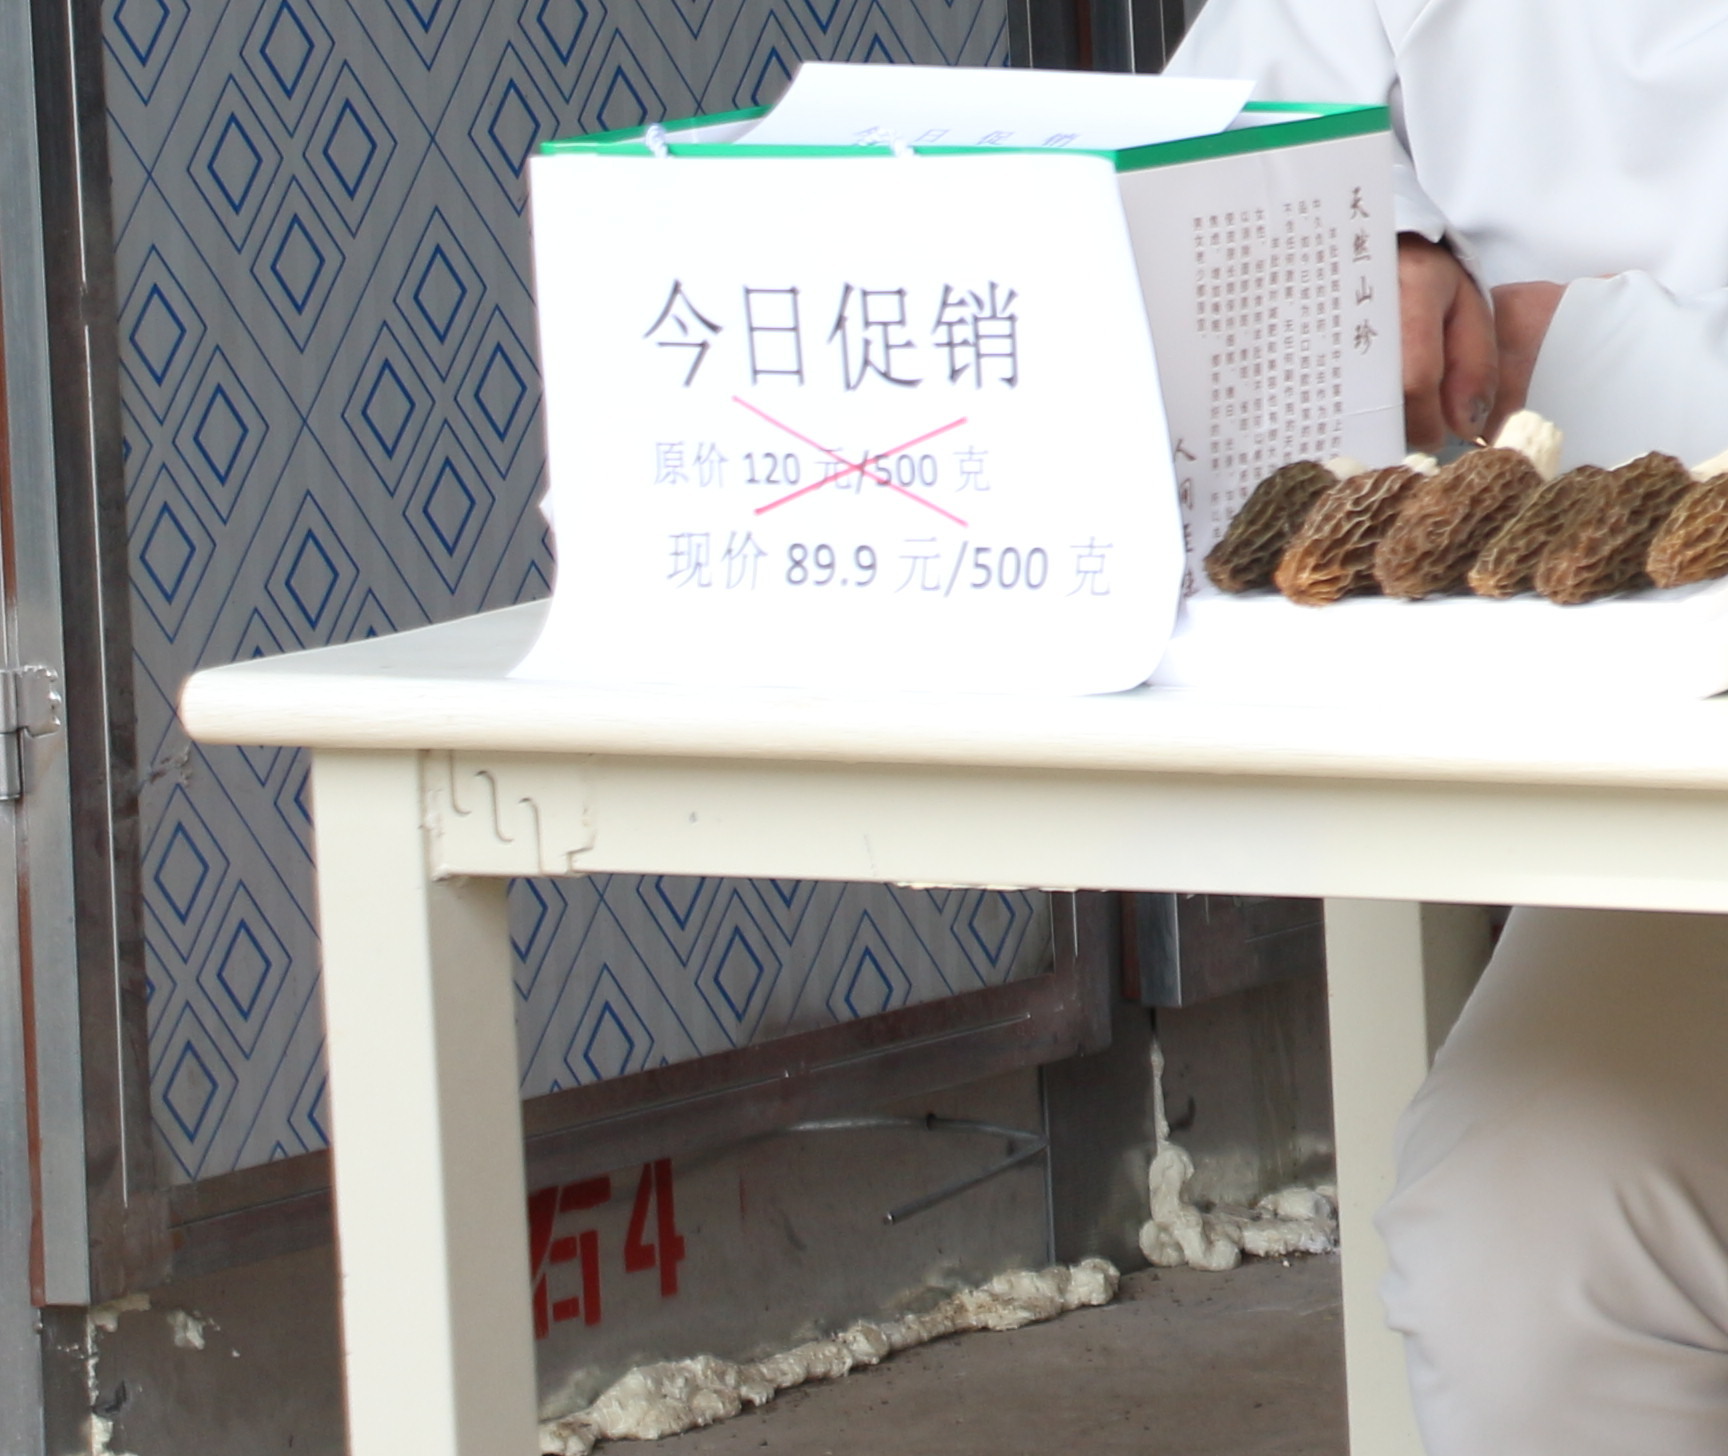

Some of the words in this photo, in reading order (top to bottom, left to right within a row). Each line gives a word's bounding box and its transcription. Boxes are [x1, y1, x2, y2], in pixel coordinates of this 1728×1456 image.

[640, 277, 1021, 392] 今日促销
[652, 440, 728, 491] 原价
[742, 453, 802, 489] 120
[814, 447, 939, 496] 元/500
[953, 444, 992, 494] 克
[666, 529, 768, 594] 现价
[785, 544, 878, 588] 89.9
[899, 537, 1050, 601] 元/500
[1067, 537, 1116, 601] 克
